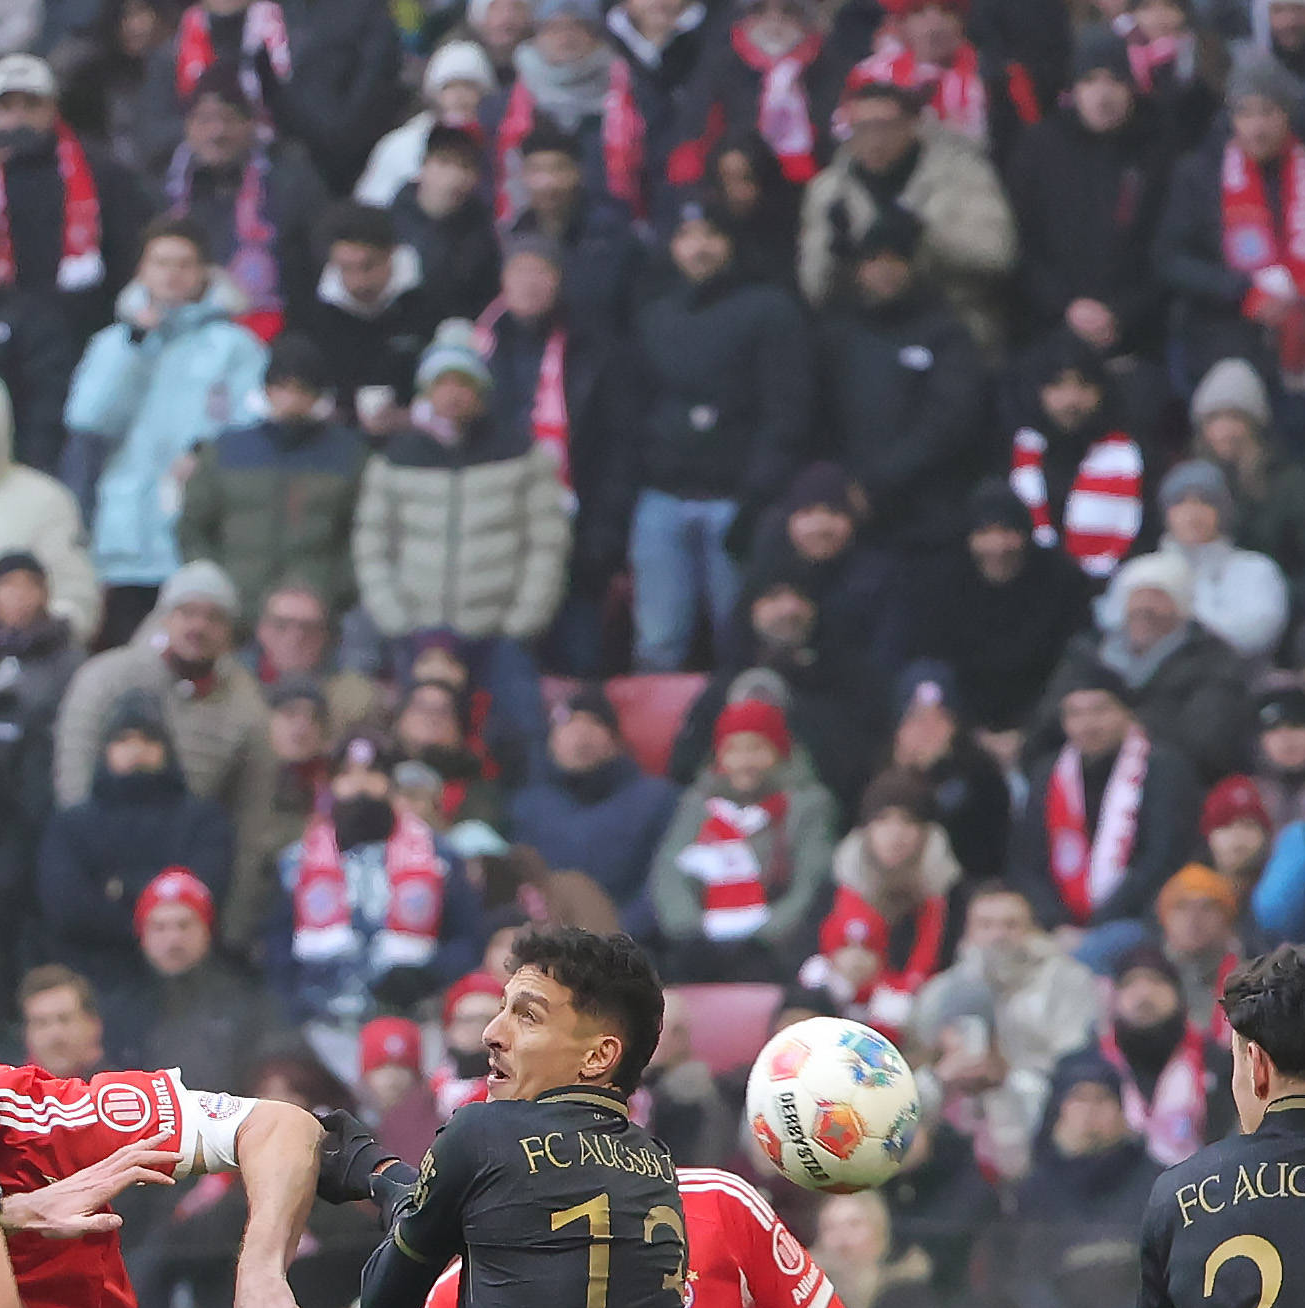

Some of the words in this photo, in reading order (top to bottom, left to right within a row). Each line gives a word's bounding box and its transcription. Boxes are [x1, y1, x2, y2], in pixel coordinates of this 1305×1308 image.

[152, 1077, 176, 1135] Allianz
[519, 1132, 573, 1174] FC
[577, 1131, 675, 1184] AUGSBU
[1175, 1175, 1226, 1228] FC
